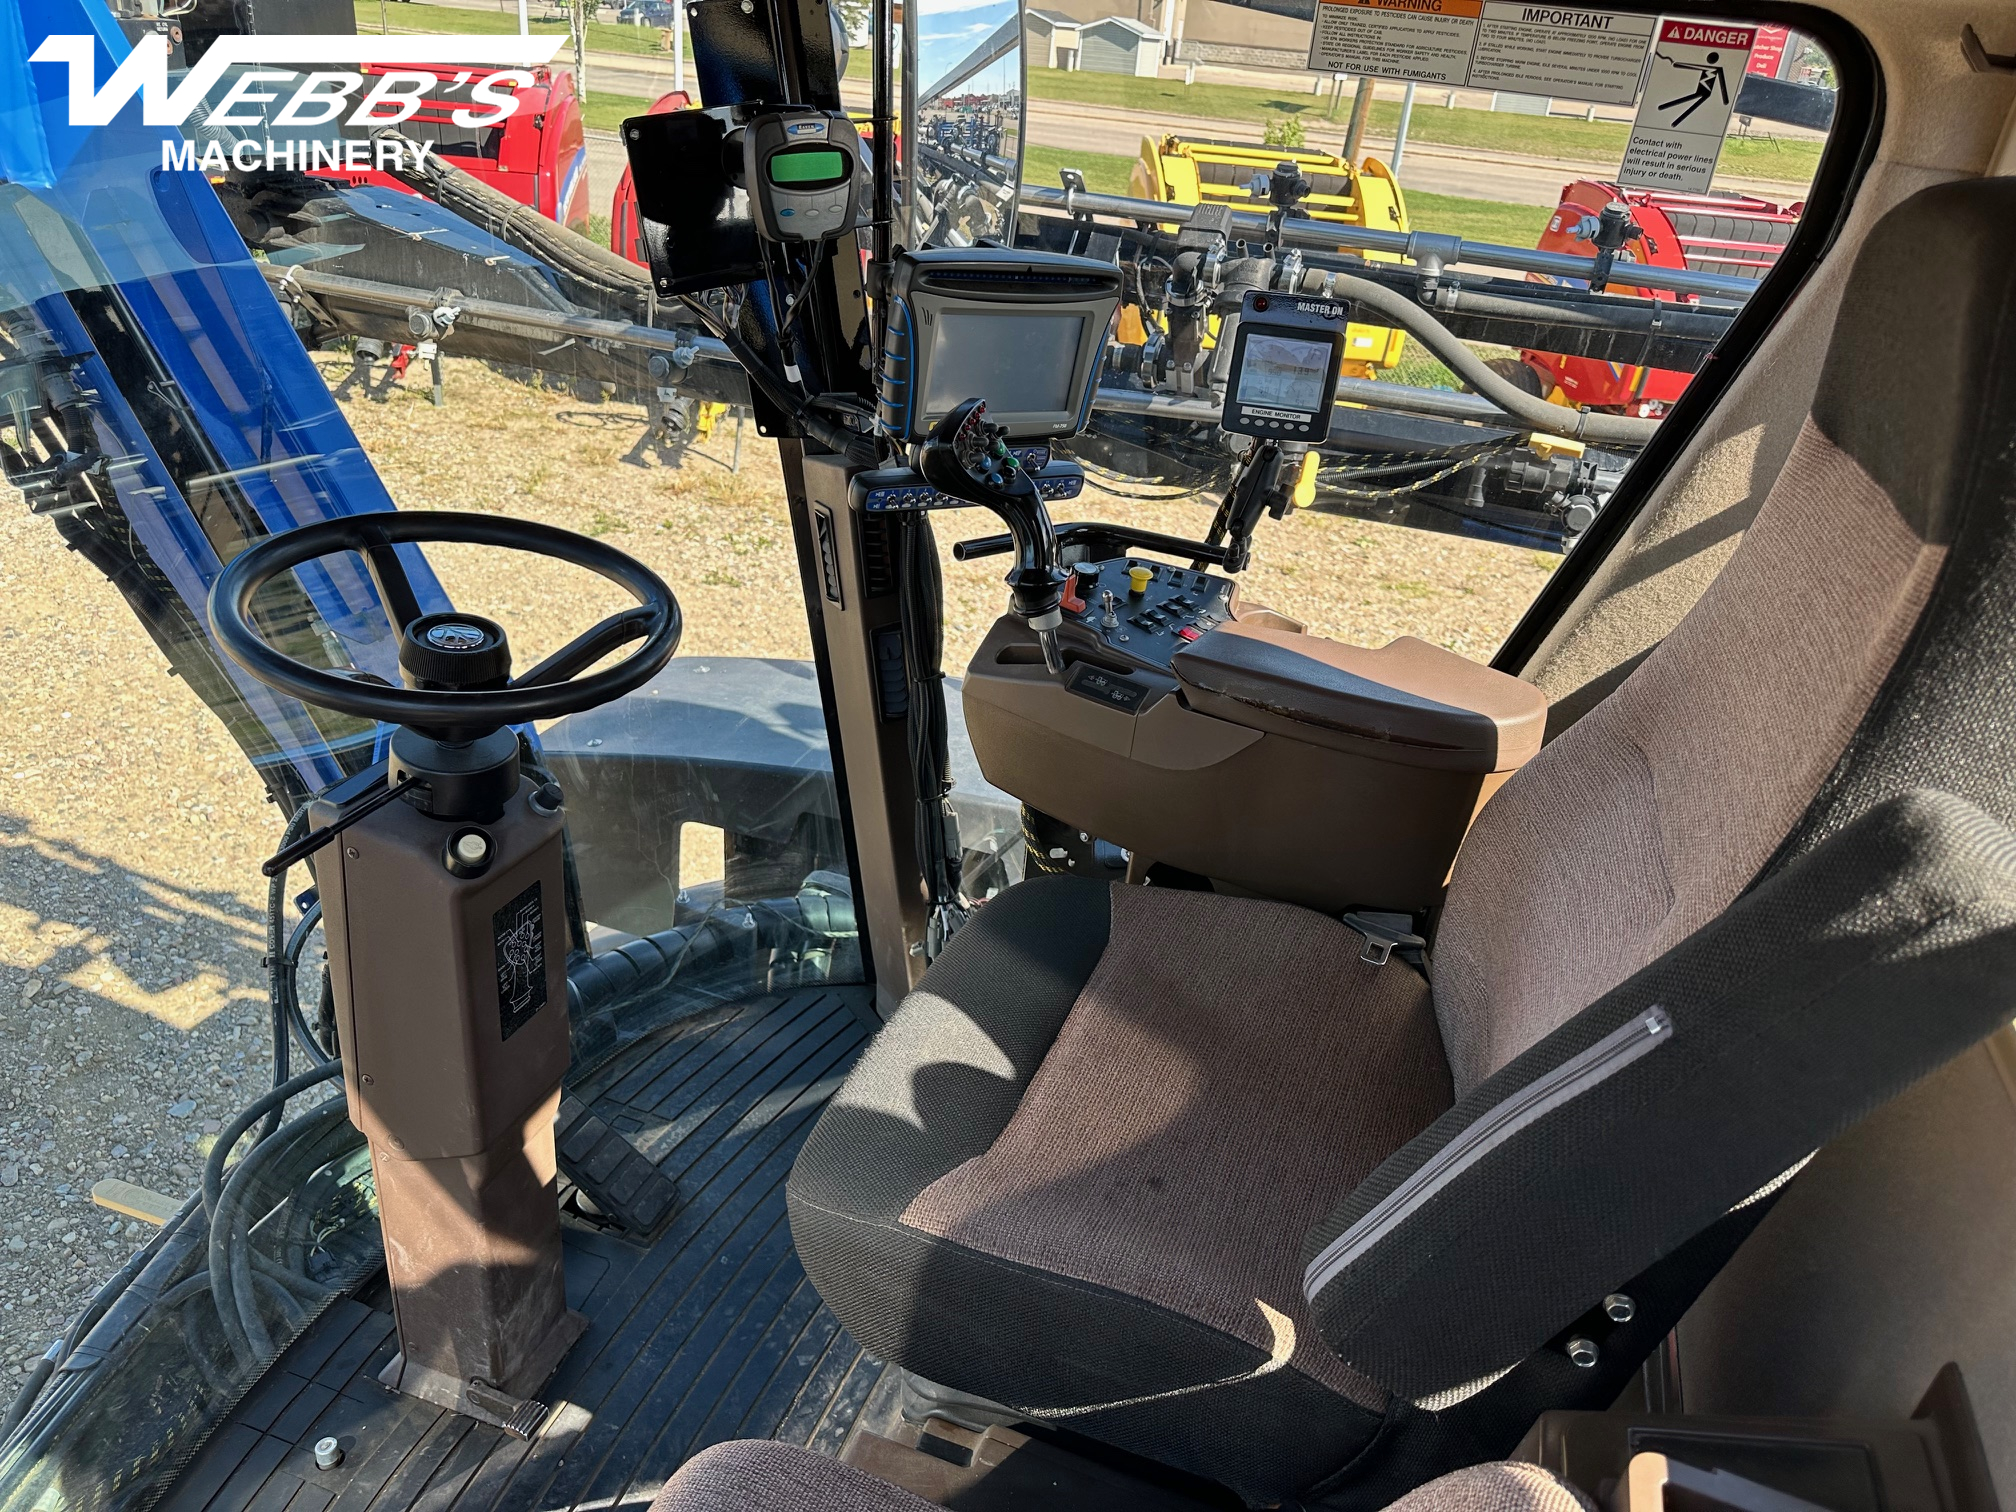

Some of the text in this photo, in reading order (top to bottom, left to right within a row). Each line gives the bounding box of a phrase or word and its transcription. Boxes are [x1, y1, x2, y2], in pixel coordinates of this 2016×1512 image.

[1521, 7, 1613, 29] IMPORTANT
[1682, 27, 1749, 45] DANGER
[1344, 62, 1361, 70] FOR
[1363, 64, 1379, 72] USE
[1381, 66, 1400, 75] WITH
[1402, 69, 1446, 80] FUMIGANTS
[1632, 136, 1683, 149] Contact with
[1628, 146, 1714, 164] electrical power lines
[1622, 166, 1646, 177] injury
[1658, 170, 1684, 181] death.
[1625, 156, 1640, 165] will
[1641, 158, 1665, 168] result
[1675, 163, 1706, 174] serious
[1297, 302, 1344, 316] MASTER ON
[1252, 408, 1301, 420] ENGINE MONITOR
